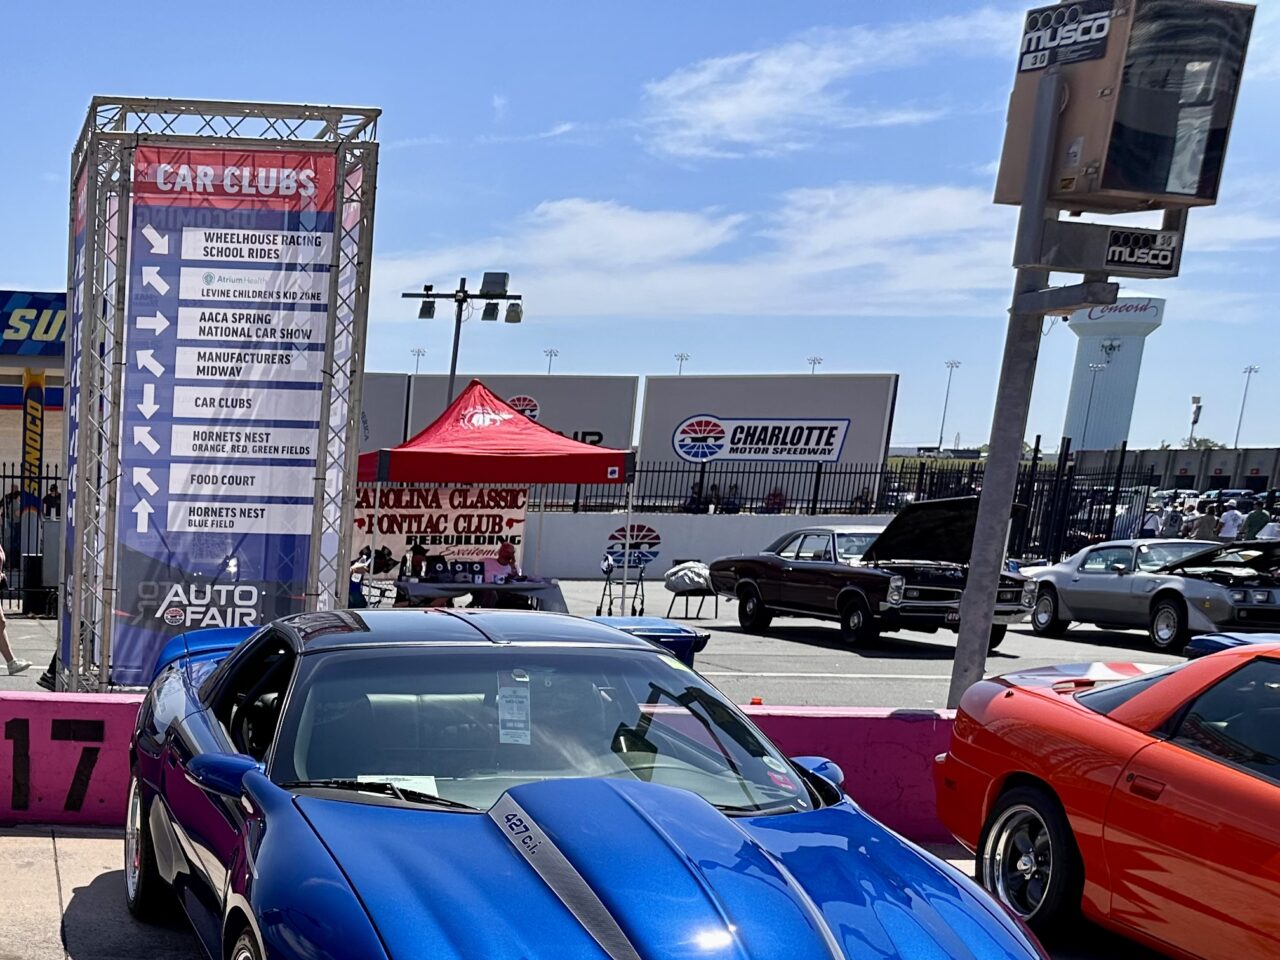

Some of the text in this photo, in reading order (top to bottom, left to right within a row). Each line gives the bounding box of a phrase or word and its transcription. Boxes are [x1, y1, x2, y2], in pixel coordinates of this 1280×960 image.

[1021, 17, 1111, 53] musco
[1031, 54, 1046, 66] 30
[157, 163, 316, 196] CAR CLUBS
[204, 232, 322, 247] WHEELHOUSE RACING
[1160, 235, 1173, 247] 30
[203, 246, 280, 259] SCHOOL RIDES
[1108, 246, 1172, 265] musco
[217, 275, 243, 284] Atrium
[201, 288, 322, 301] LEVINE CHILDRENS KID ZONE
[1088, 298, 1159, 321] Concord
[199, 311, 272, 325] AACA SPRING
[198, 325, 313, 340] NATIONAL CAR SHOW
[196, 365, 243, 377] MIDWAY
[194, 396, 252, 409] CAR CLUBS
[193, 431, 271, 443] HORNETS NEST
[730, 425, 838, 446] CHARLOTTE
[24, 400, 42, 497] SUNOCO
[192, 444, 310, 455] ORANGE, RED, GREEN FIELDS
[772, 447, 833, 455] SPEEDWAY
[191, 475, 256, 486] FOOD COURT
[449, 488, 528, 510] CLASSIC
[189, 507, 266, 519] HORNETS NEST
[188, 519, 234, 529] BLUE FIELD
[453, 514, 504, 535] CLUB
[406, 535, 522, 546] REBUILDING
[154, 583, 258, 618] AUTO
[185, 606, 257, 628] FAIR
[4, 717, 105, 812] 17
[504, 812, 530, 840] 427
